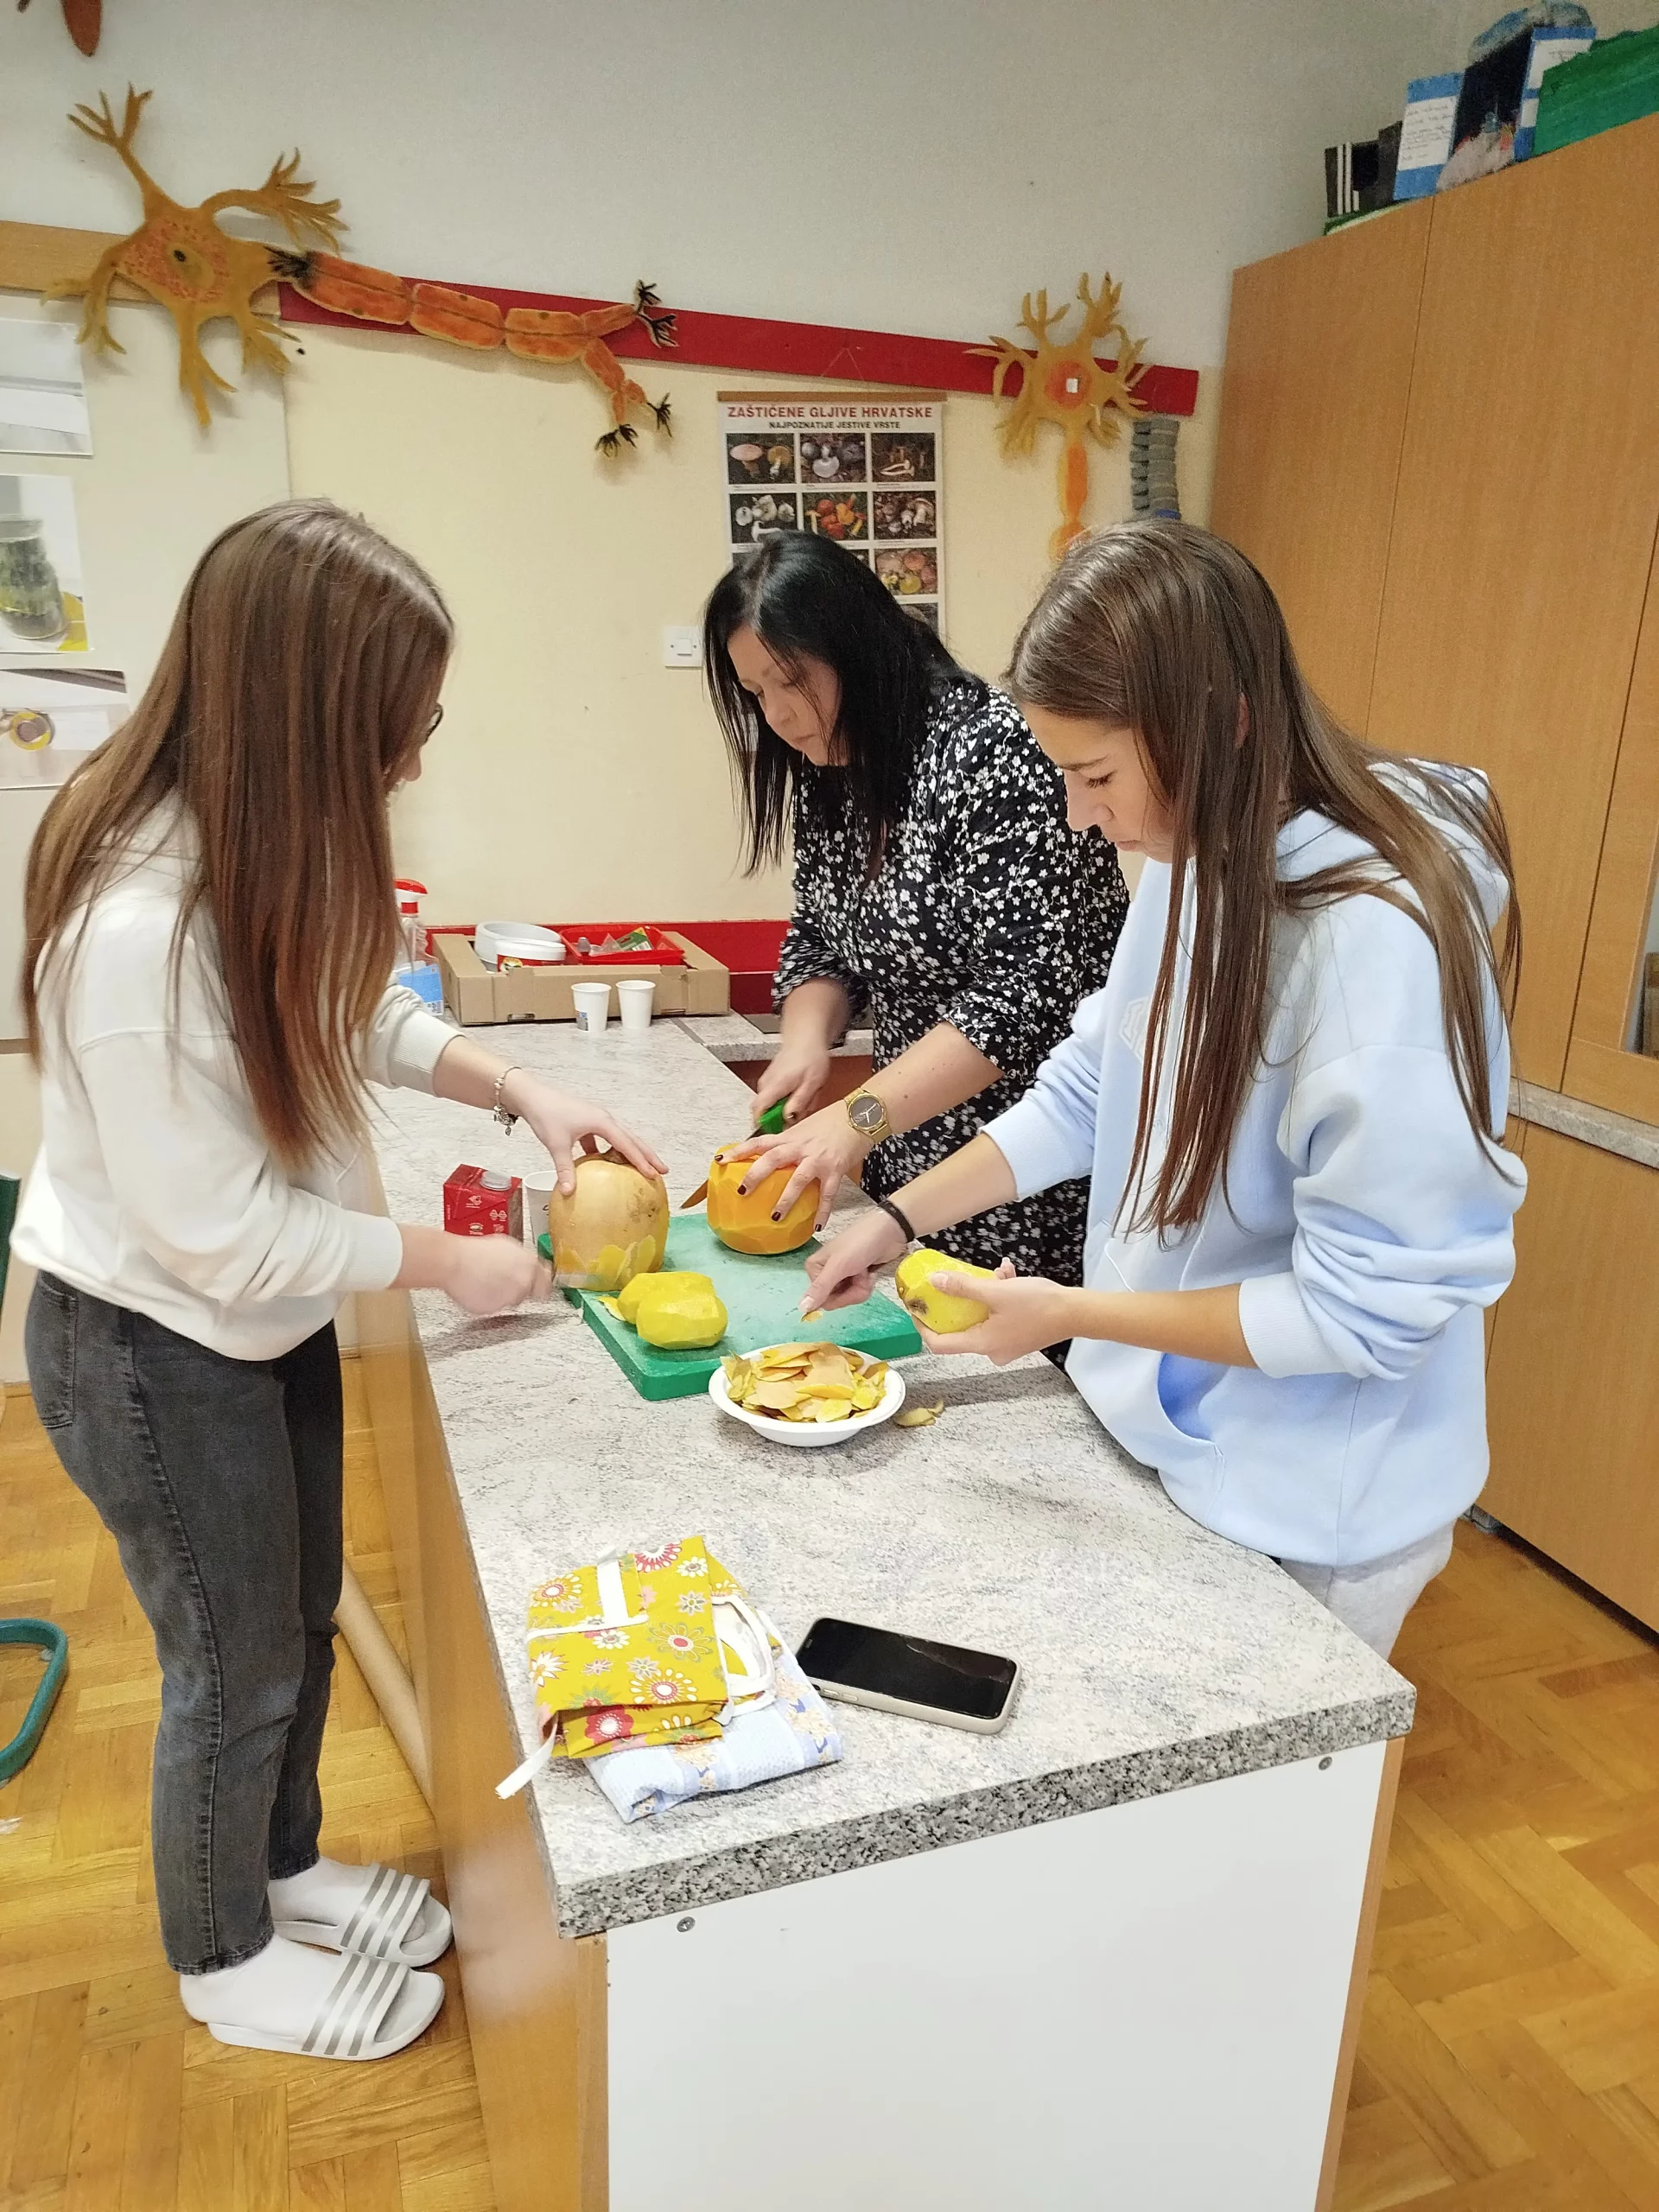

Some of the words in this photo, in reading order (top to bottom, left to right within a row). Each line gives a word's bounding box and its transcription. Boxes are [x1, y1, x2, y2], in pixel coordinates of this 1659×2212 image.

[810, 406, 857, 418] GLJIVE
[861, 406, 932, 418] HRVATSKE
[768, 421, 835, 429] NAJPOZNATIJE
[836, 421, 872, 429] JESTIVE
[874, 421, 901, 429] VRSTE
